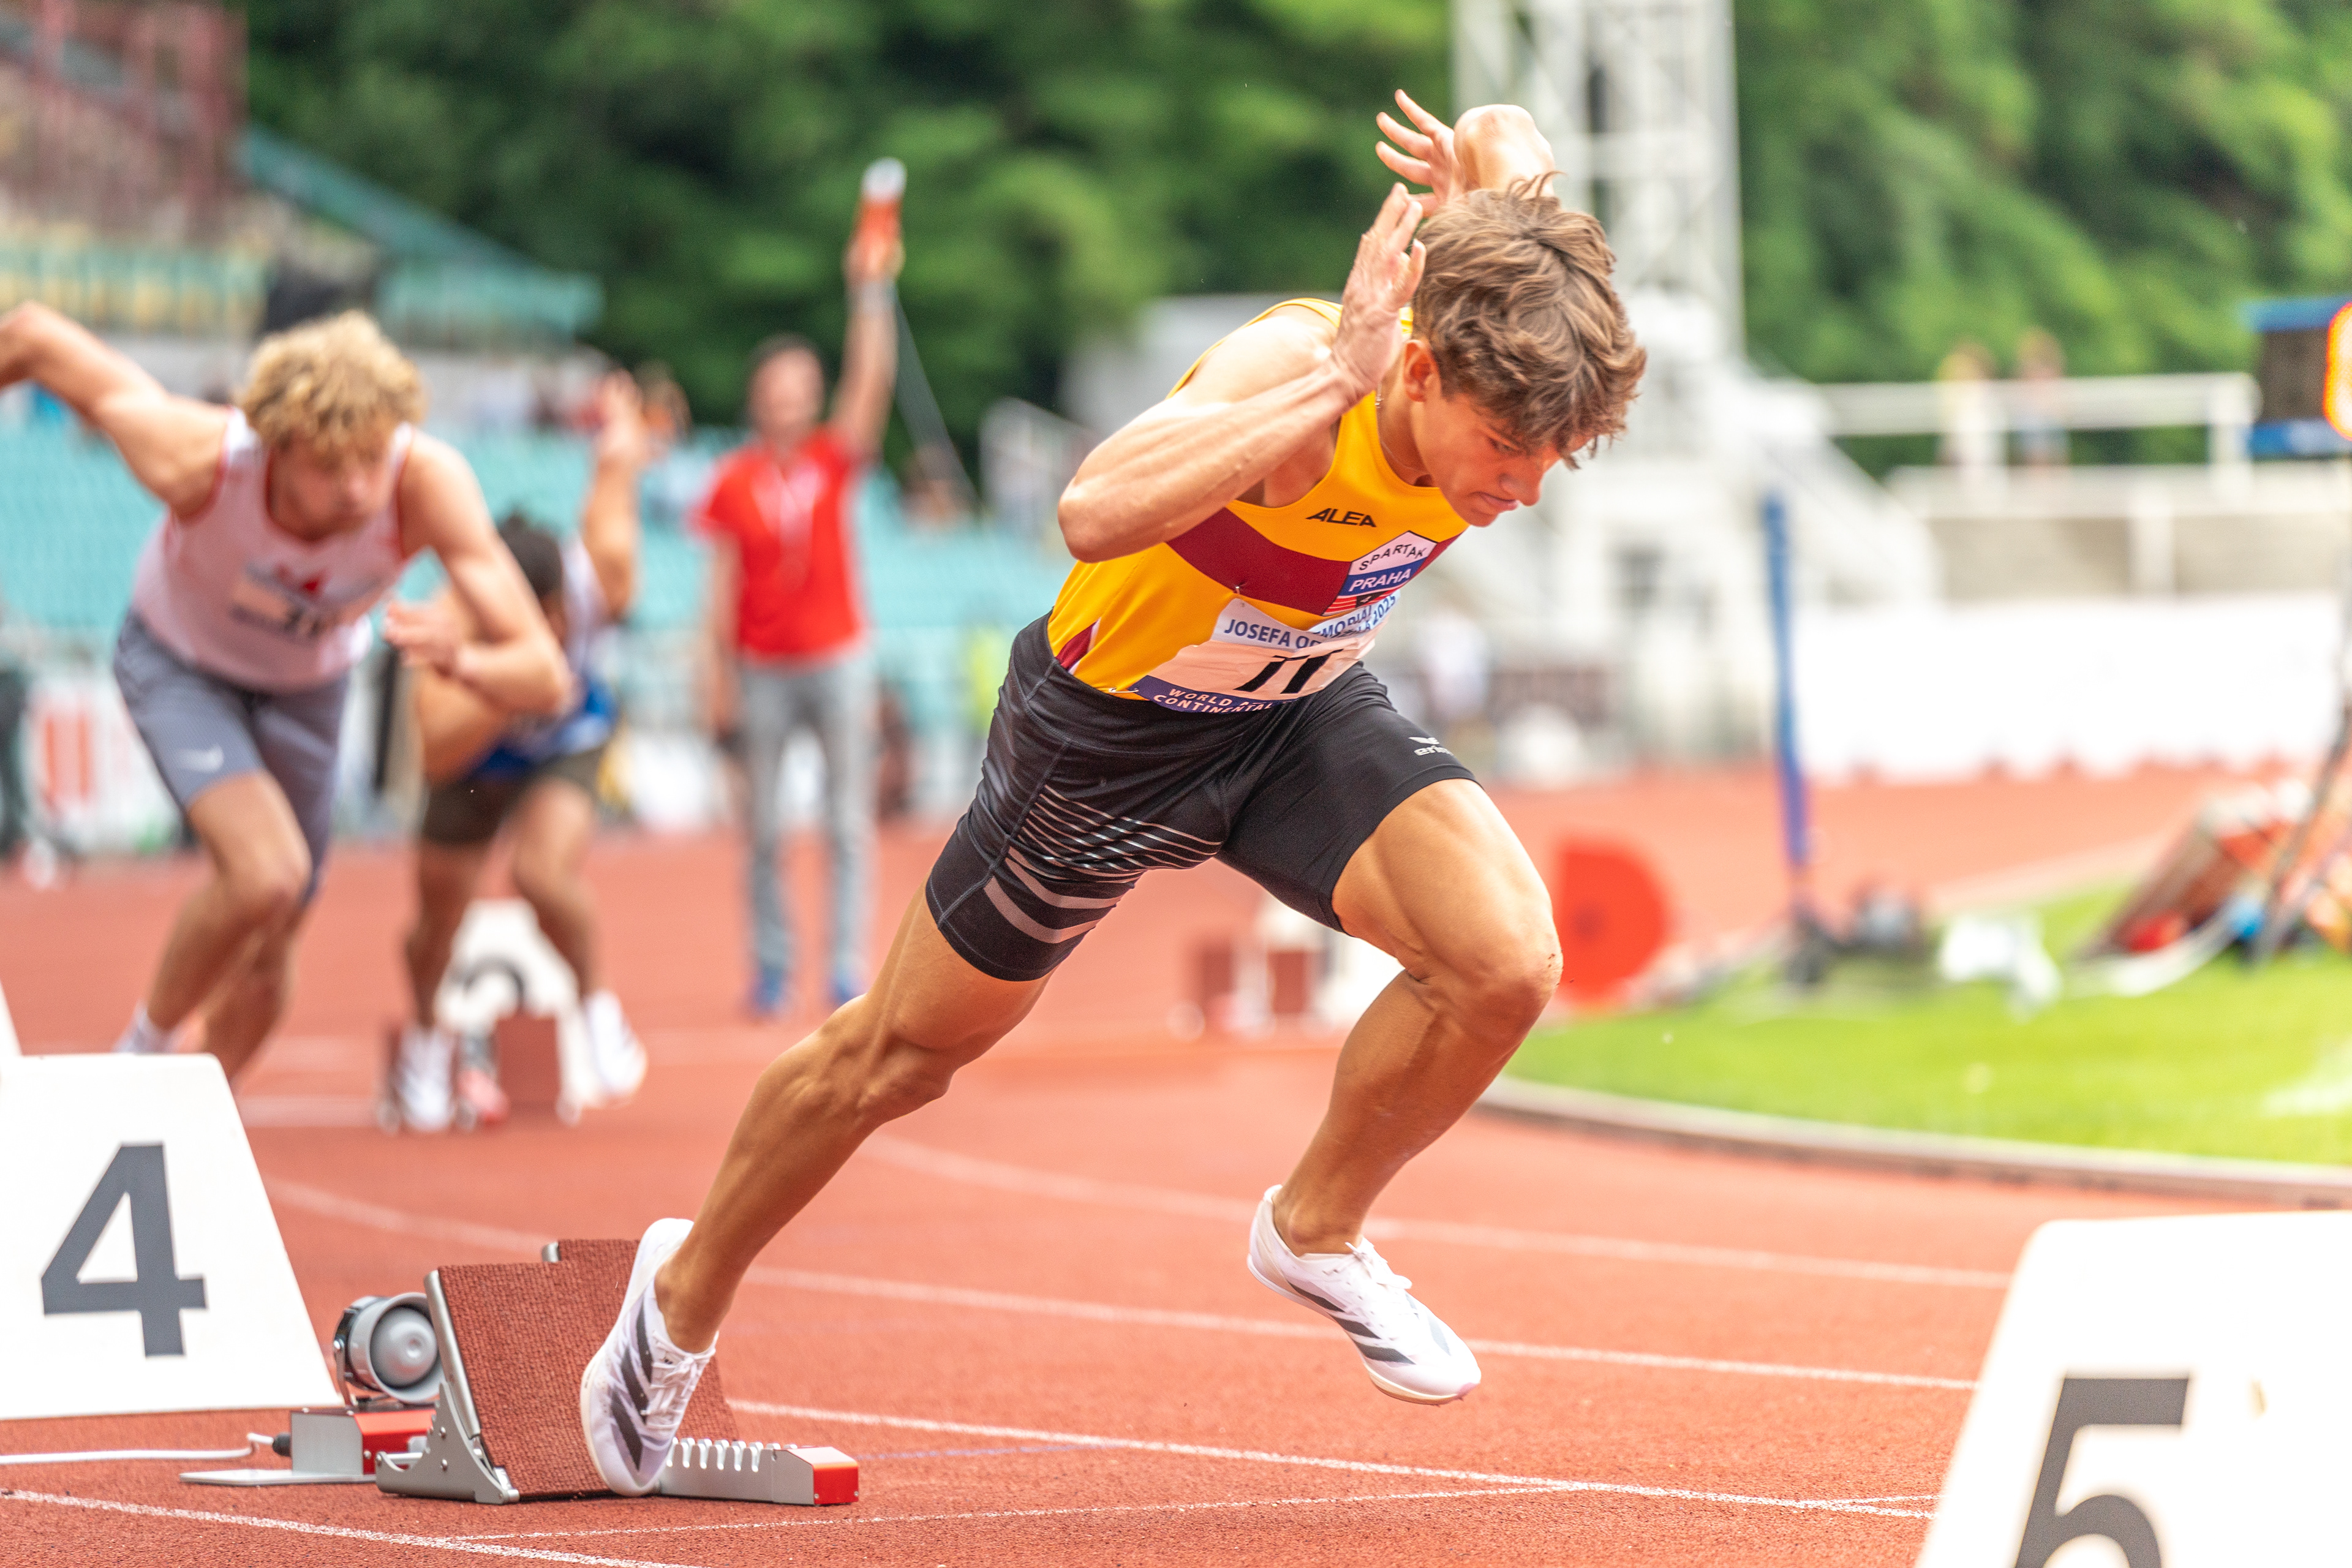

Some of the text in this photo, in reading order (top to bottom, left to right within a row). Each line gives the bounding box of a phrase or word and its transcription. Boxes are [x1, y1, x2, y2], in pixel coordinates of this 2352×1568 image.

[1305, 508, 1377, 527] ALEA
[1359, 543, 1427, 571] SPARTAK
[1348, 568, 1411, 592] PRAHA
[1224, 619, 1291, 647] JOSEFA
[1373, 595, 1396, 625] 2025
[1153, 694, 1273, 714] CONTINENTAL
[1168, 688, 1233, 706] WORLD
[40, 1140, 208, 1358] 4
[2014, 1376, 2191, 1568] 5
